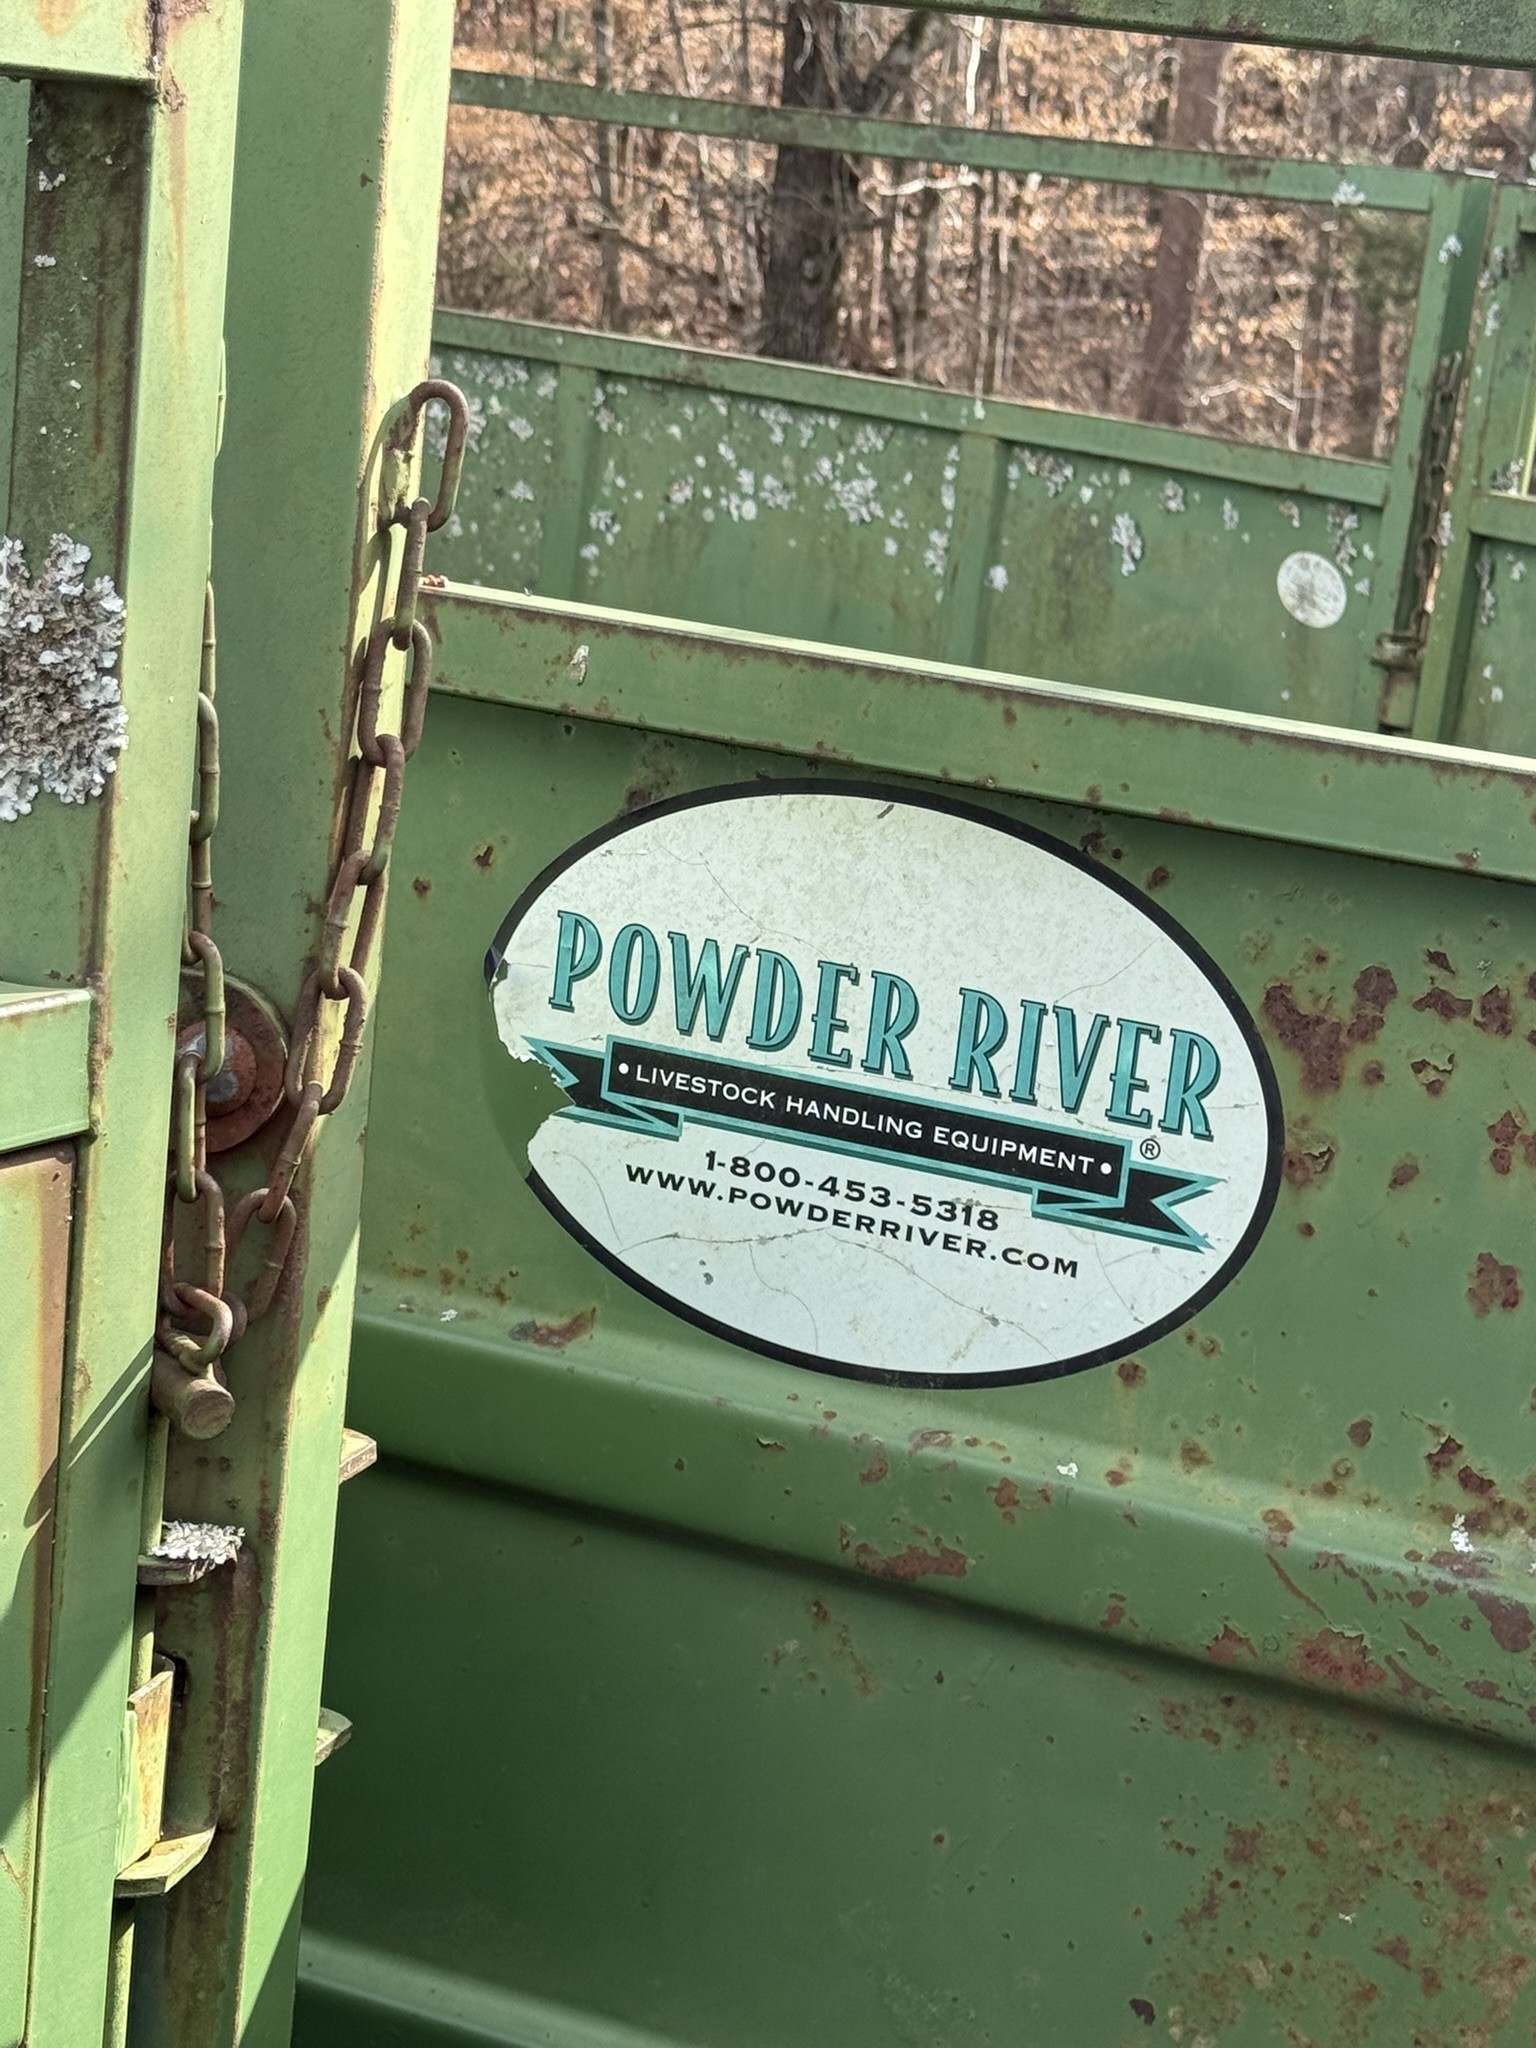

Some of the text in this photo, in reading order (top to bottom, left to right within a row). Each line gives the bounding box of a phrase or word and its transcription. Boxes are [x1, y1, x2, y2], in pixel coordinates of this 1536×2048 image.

[548, 910, 1221, 1141] POWDER RIVER
[636, 1065, 1094, 1175] LIVESTOCK HANDLING EQUIPMENT
[626, 1165, 1079, 1278] WWW.POWDERRIVER.COM
[704, 1151, 1000, 1232] 1-800-453-5318
